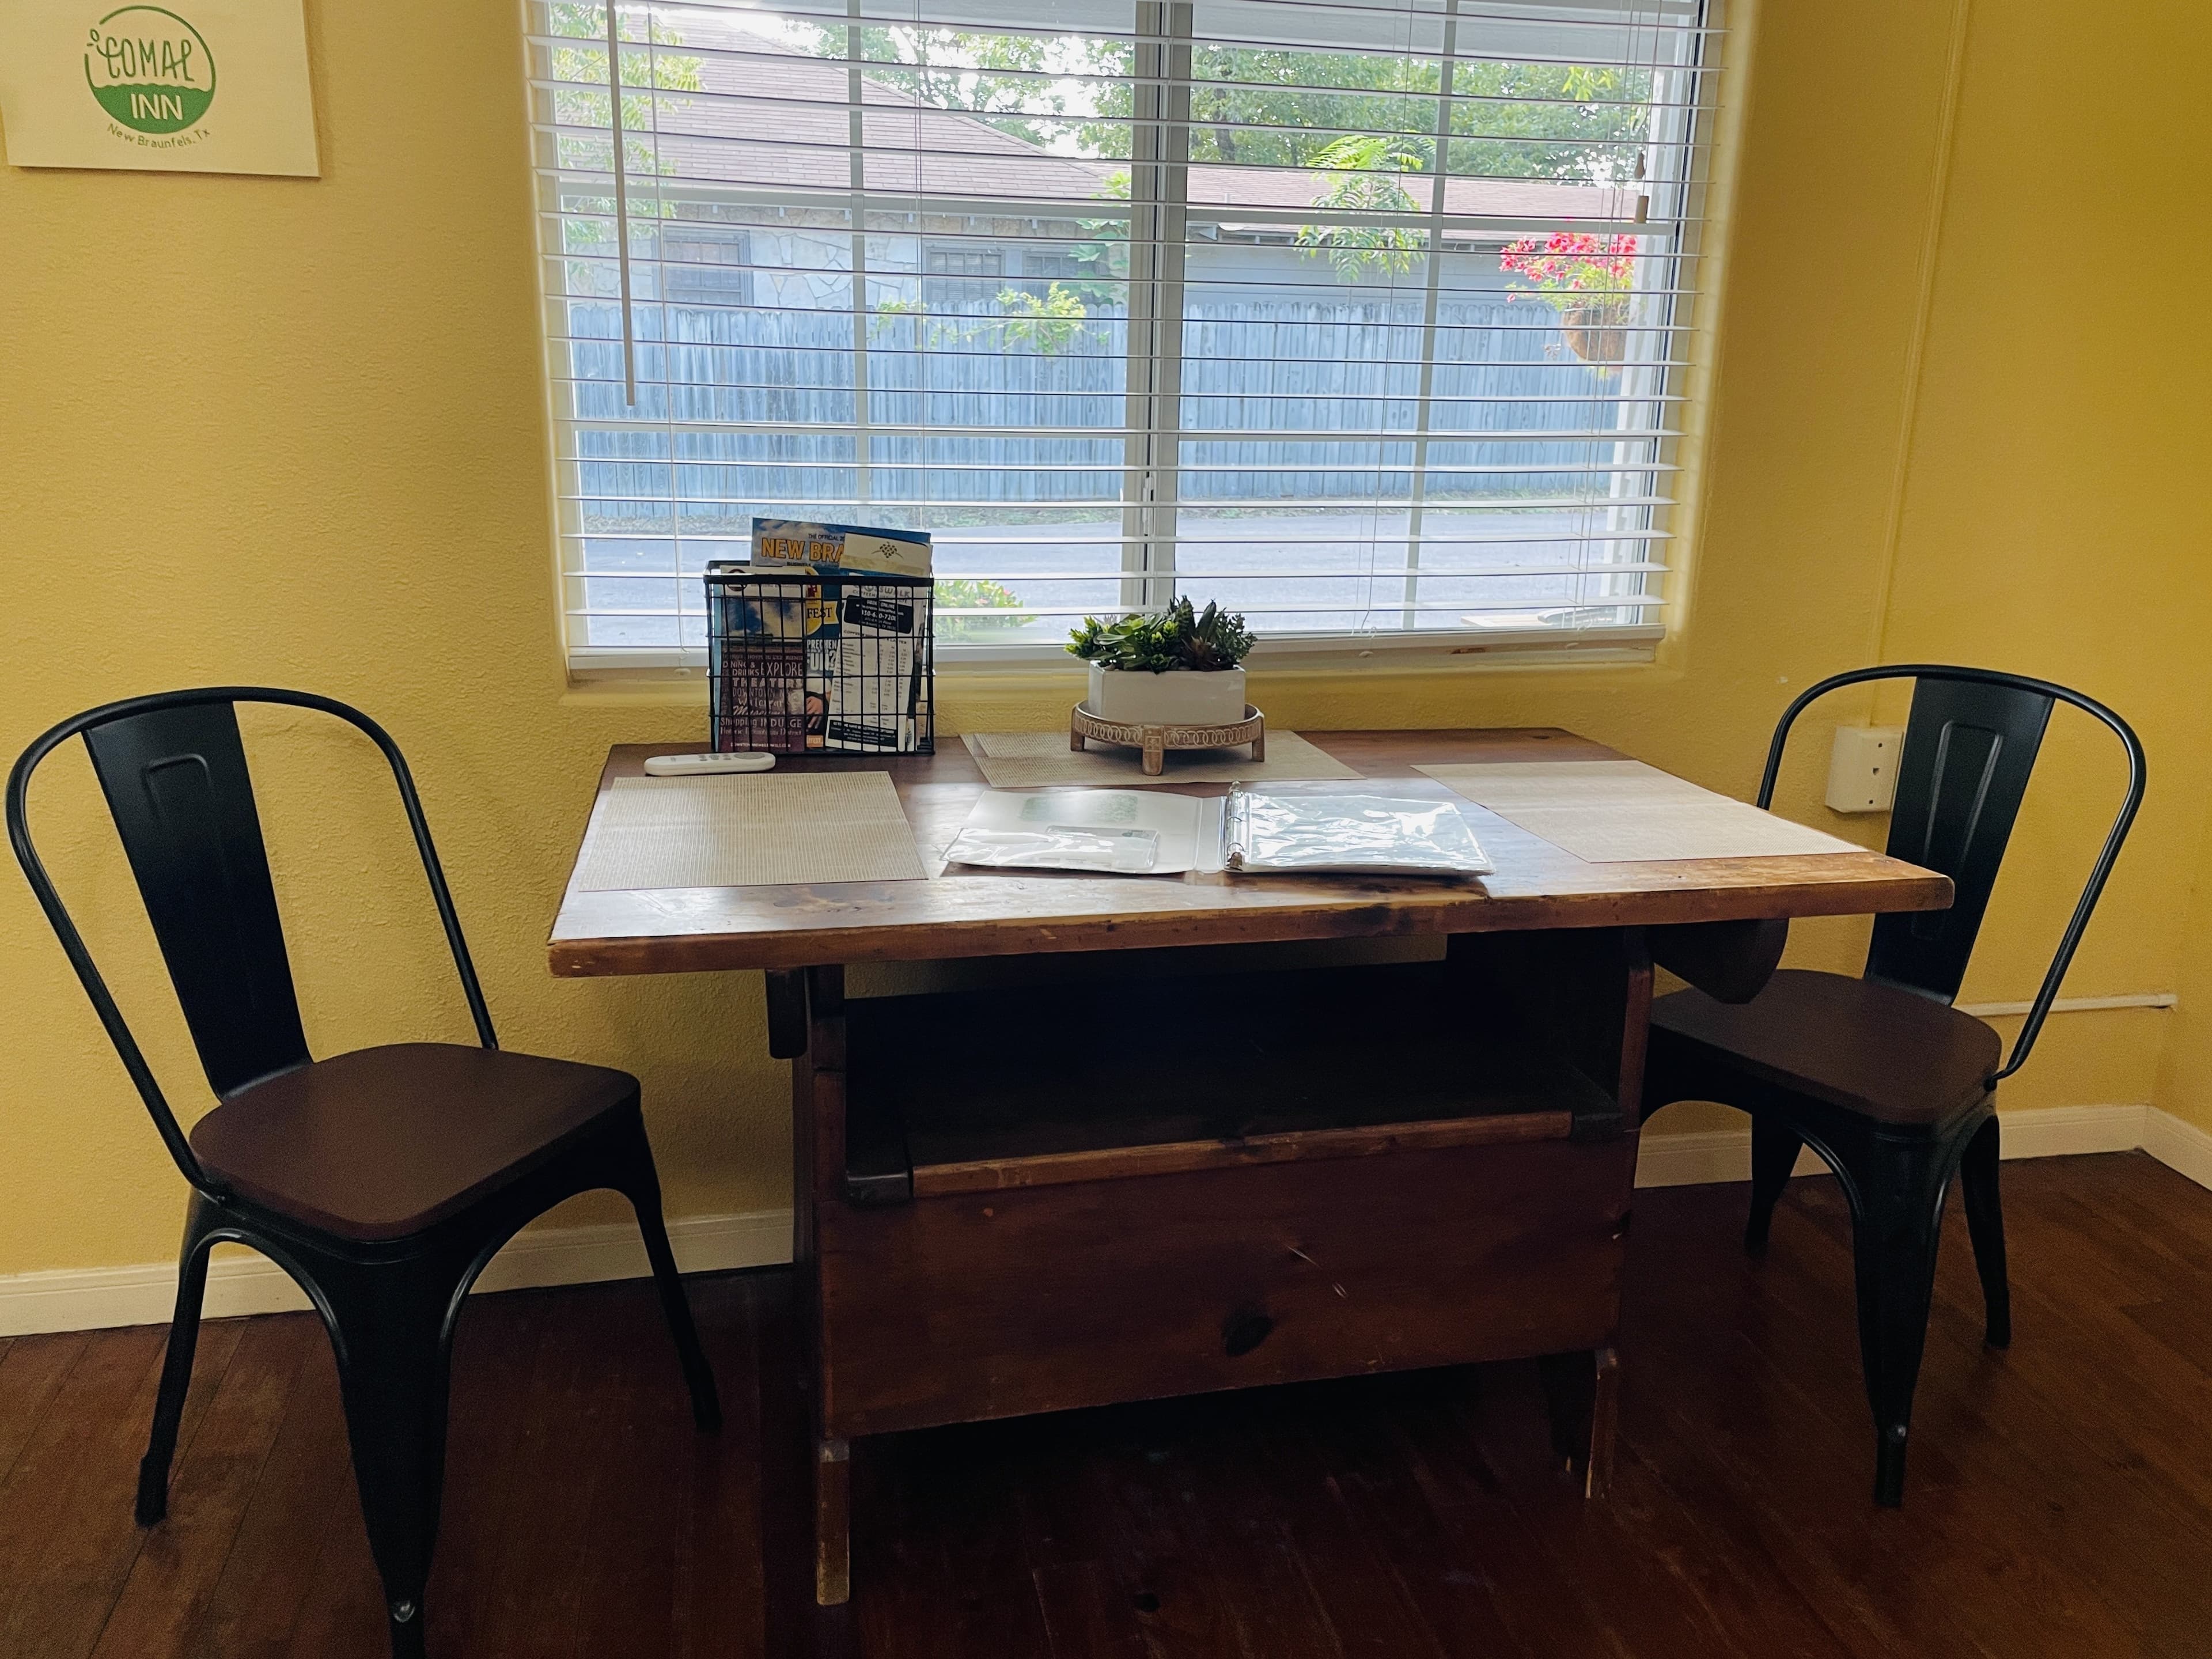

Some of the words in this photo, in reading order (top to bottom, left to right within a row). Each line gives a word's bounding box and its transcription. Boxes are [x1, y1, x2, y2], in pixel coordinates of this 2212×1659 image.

[100, 36, 195, 82] COMAL
[131, 93, 183, 120] INN
[107, 123, 135, 142] New
[762, 537, 805, 560] NEW
[809, 541, 844, 563] BRA
[807, 607, 832, 619] FEST
[806, 639, 837, 650] PRECHEN
[723, 660, 747, 668] DNIN
[760, 662, 803, 676] EXPLORE
[720, 717, 757, 728] Shppig
[760, 718, 802, 728] INDUGE
